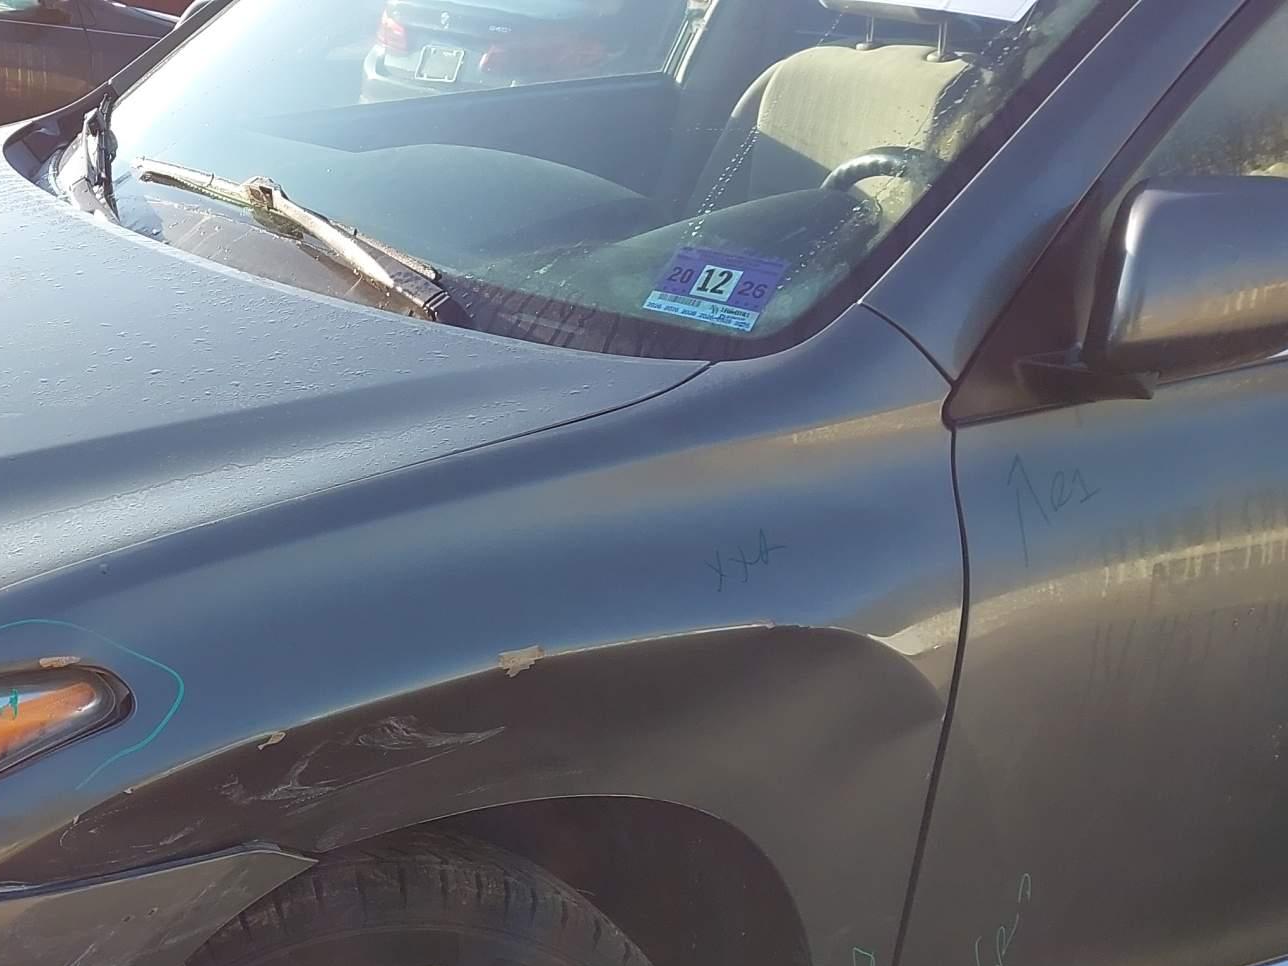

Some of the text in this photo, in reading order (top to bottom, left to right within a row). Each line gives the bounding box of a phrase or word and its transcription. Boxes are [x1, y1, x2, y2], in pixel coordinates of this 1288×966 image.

[667, 266, 768, 299] 20 12 26
